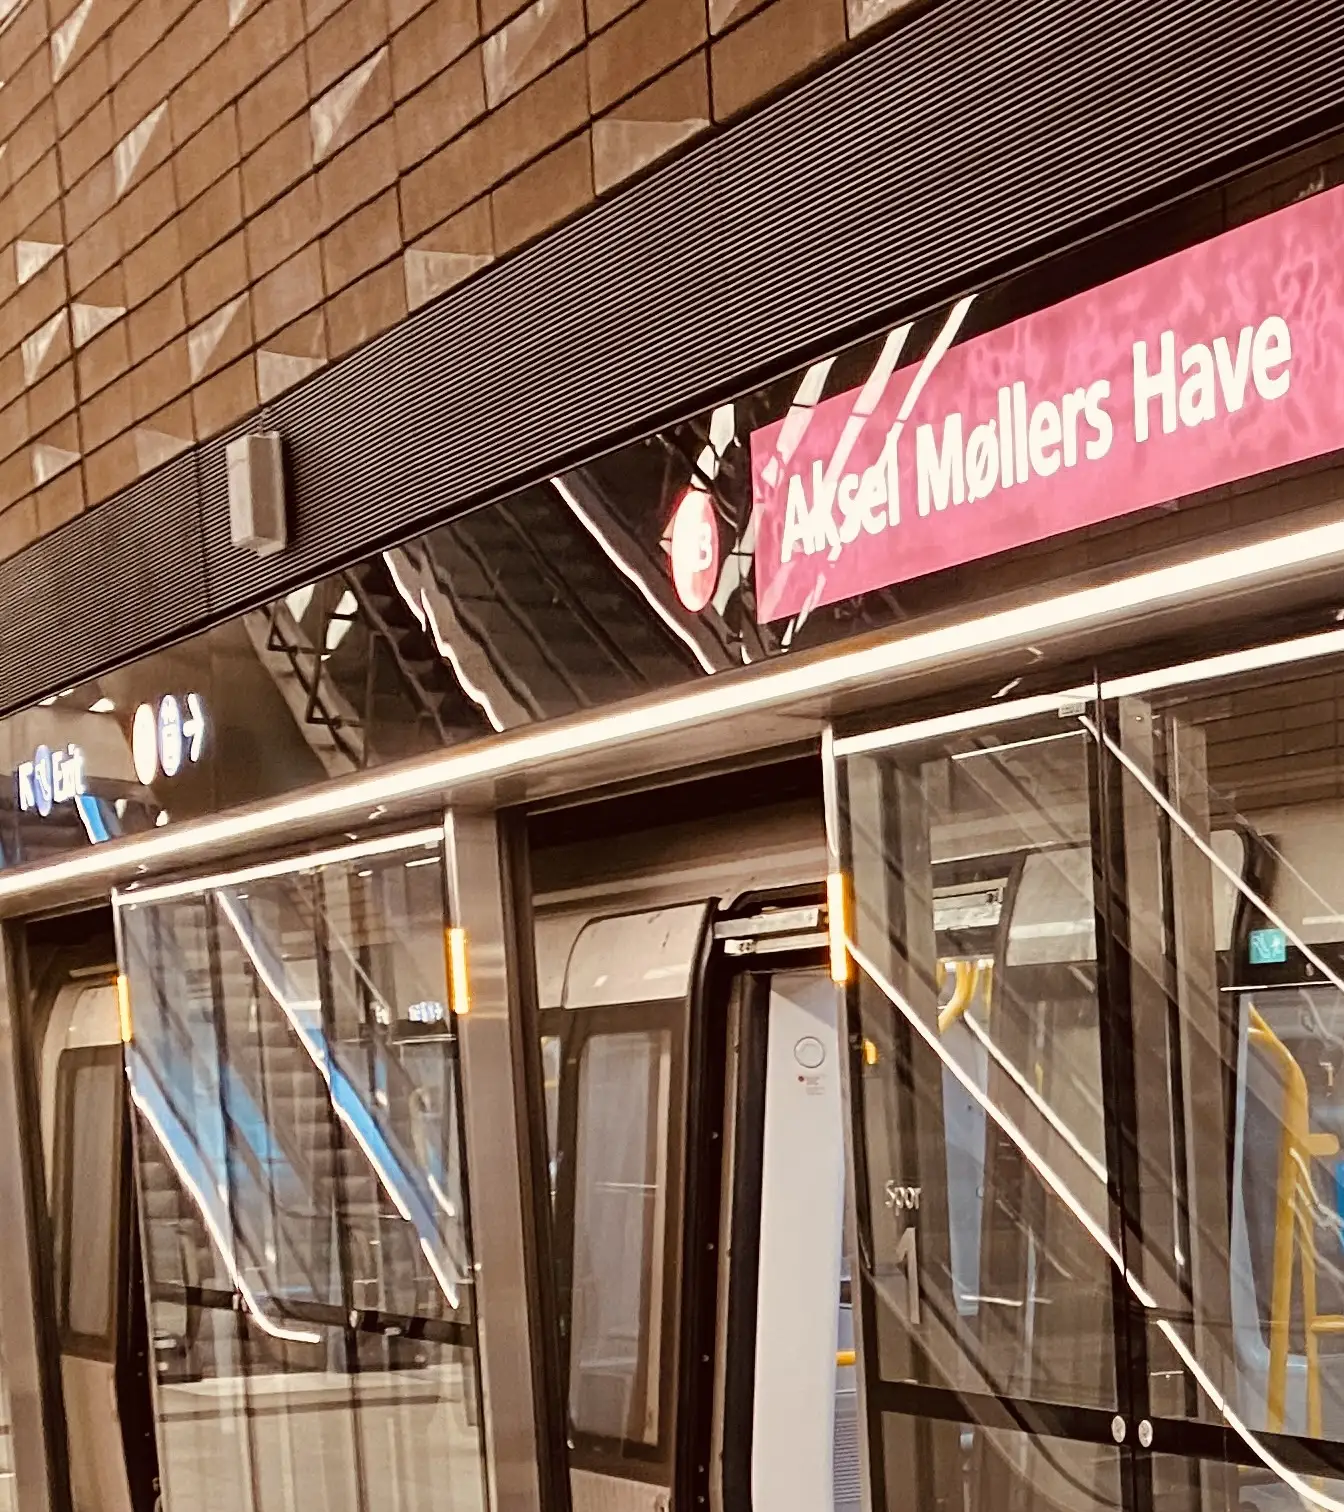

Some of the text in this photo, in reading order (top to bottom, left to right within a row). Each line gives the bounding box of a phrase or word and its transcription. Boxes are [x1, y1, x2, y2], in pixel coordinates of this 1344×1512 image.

[780, 314, 1292, 564] Aksel Møllers Have
[885, 1180, 921, 1216] Spor
[896, 1227, 920, 1324] 1
